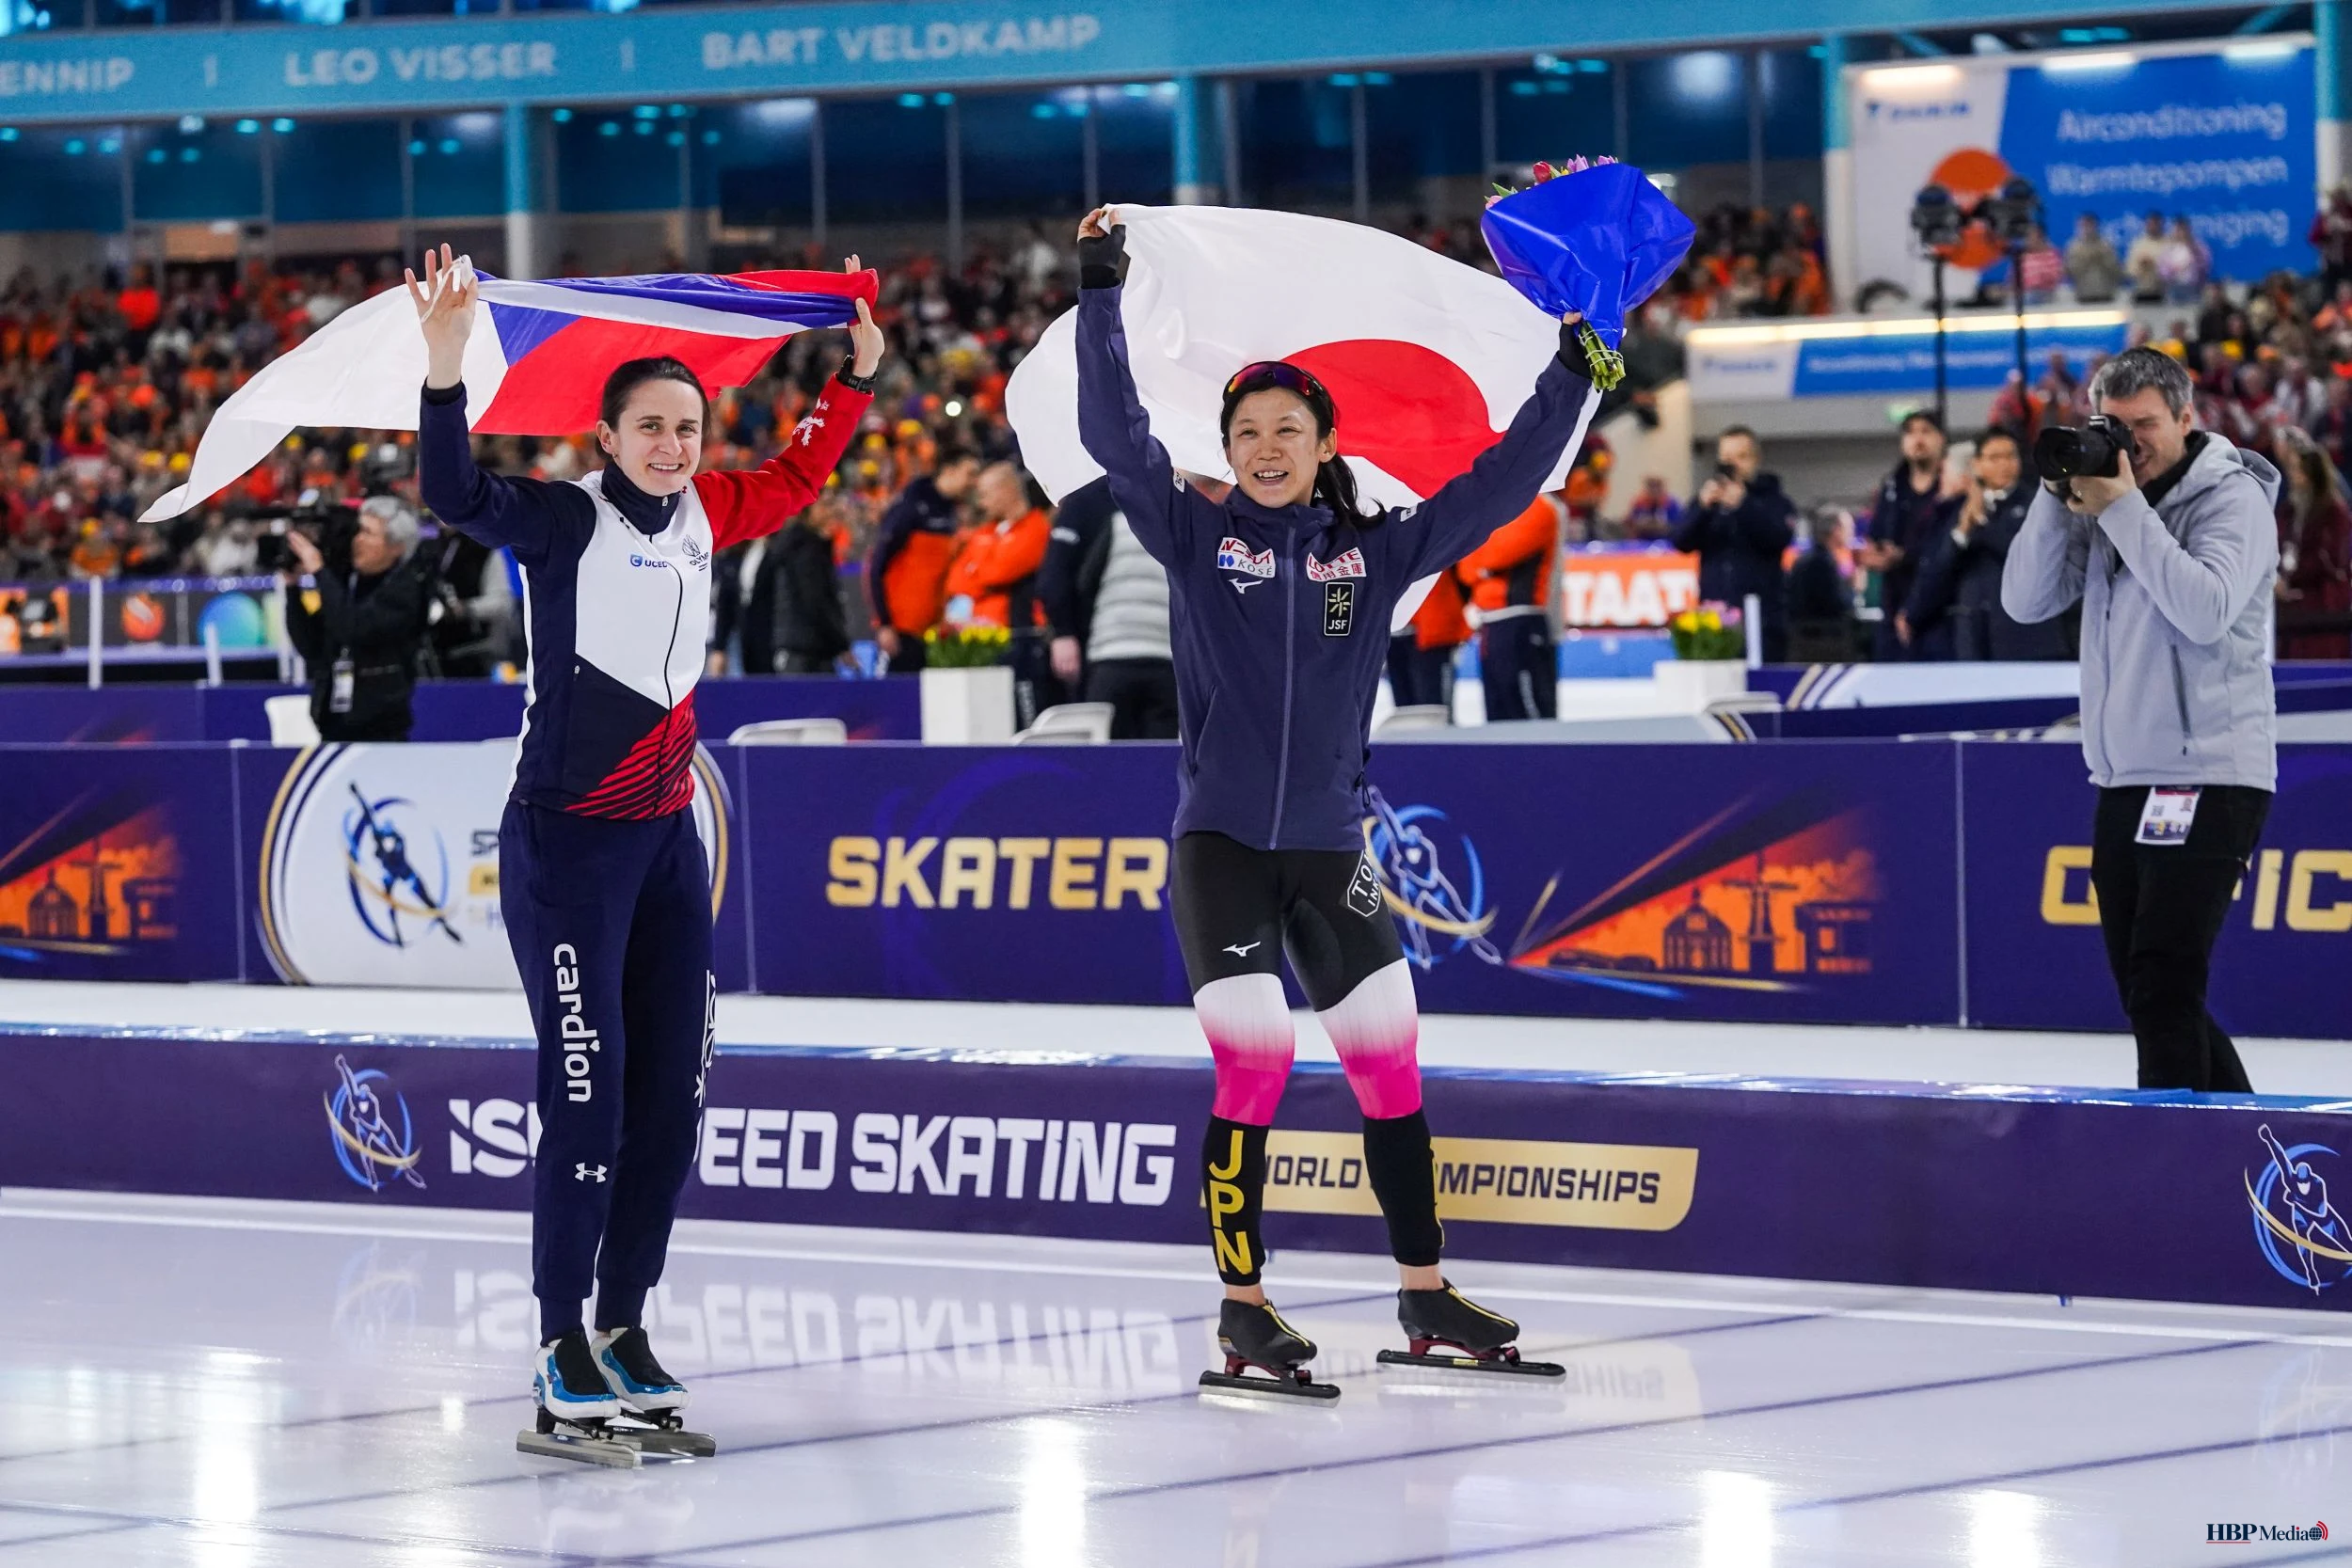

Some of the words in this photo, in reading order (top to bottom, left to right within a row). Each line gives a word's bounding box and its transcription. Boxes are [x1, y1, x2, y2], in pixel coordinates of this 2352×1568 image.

[284, 48, 378, 87] LEO
[390, 41, 557, 82] VISSER
[702, 27, 825, 70] BART
[837, 14, 1101, 62] VELDKAMP
[2057, 102, 2289, 143] Airconditioning
[2045, 155, 2289, 196] Warmtepompen
[1327, 619, 1348, 630] JSF
[826, 835, 1169, 911] SKATER
[553, 943, 600, 1102] cardion
[692, 1107, 839, 1190] EED
[850, 1112, 1177, 1207] SKATING
[1438, 1162, 1661, 1205] MPIONSHIPS
